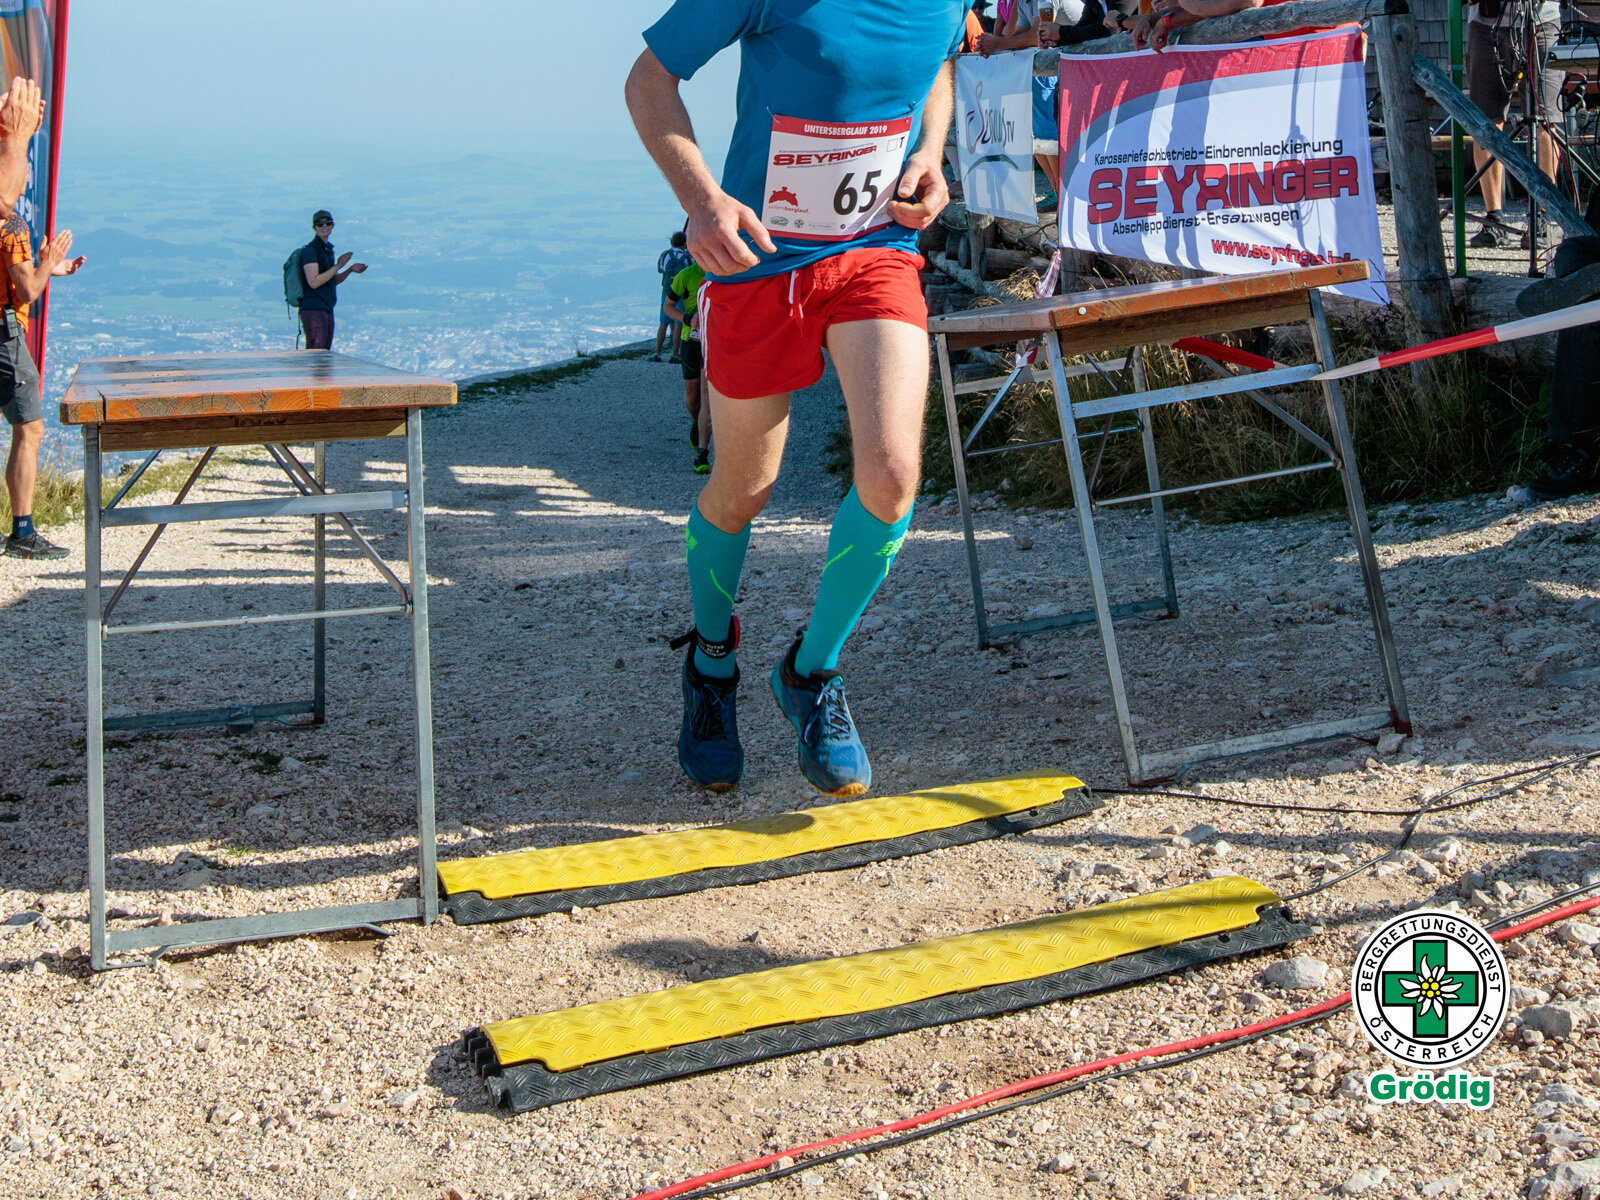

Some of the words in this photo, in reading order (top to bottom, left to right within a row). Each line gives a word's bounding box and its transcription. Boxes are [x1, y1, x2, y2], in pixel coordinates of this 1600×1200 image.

[804, 124, 868, 136] UNTERSBERGLAUF
[869, 124, 888, 135] 2019
[773, 145, 877, 166] SEYRINGER
[833, 170, 882, 216] 65
[1087, 155, 1359, 225] SEYRINGER
